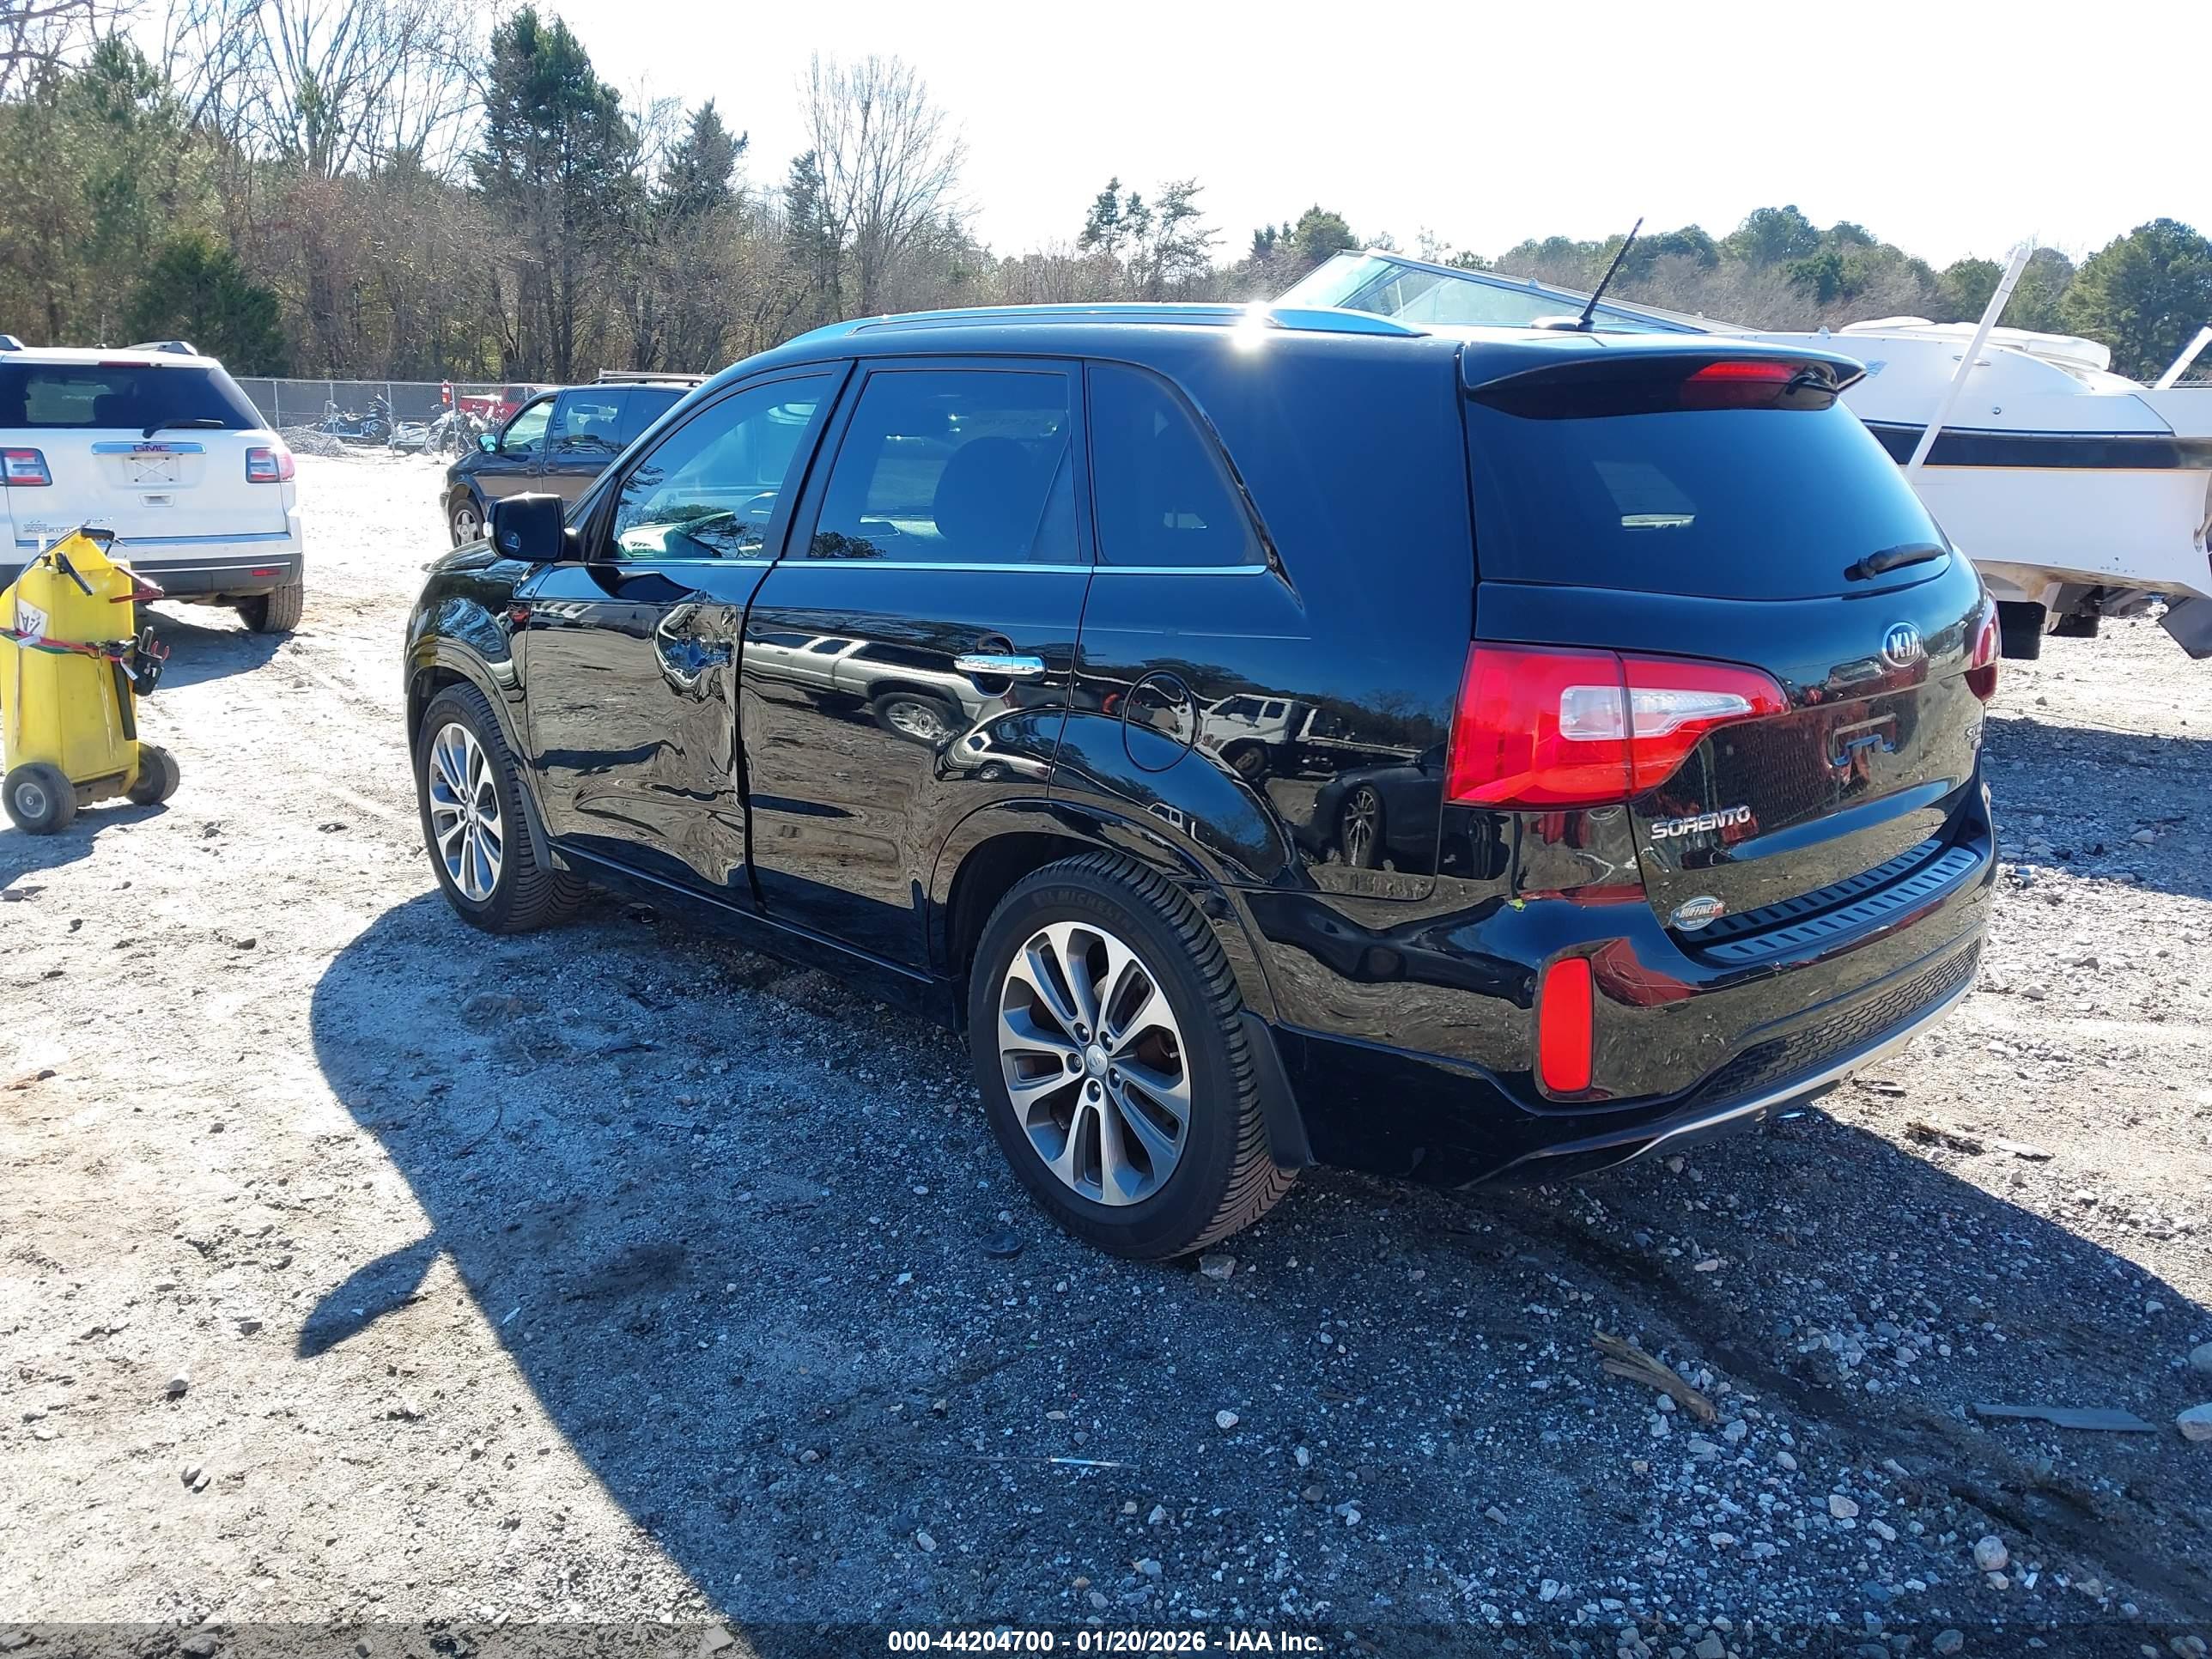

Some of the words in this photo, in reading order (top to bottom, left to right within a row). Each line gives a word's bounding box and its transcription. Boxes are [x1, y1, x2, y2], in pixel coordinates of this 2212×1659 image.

[1890, 630, 1920, 659] KIA
[1650, 805, 1751, 840] SORENTO
[1057, 890, 1135, 930] MICHELIN
[1679, 902, 1717, 919] HUFFINES
